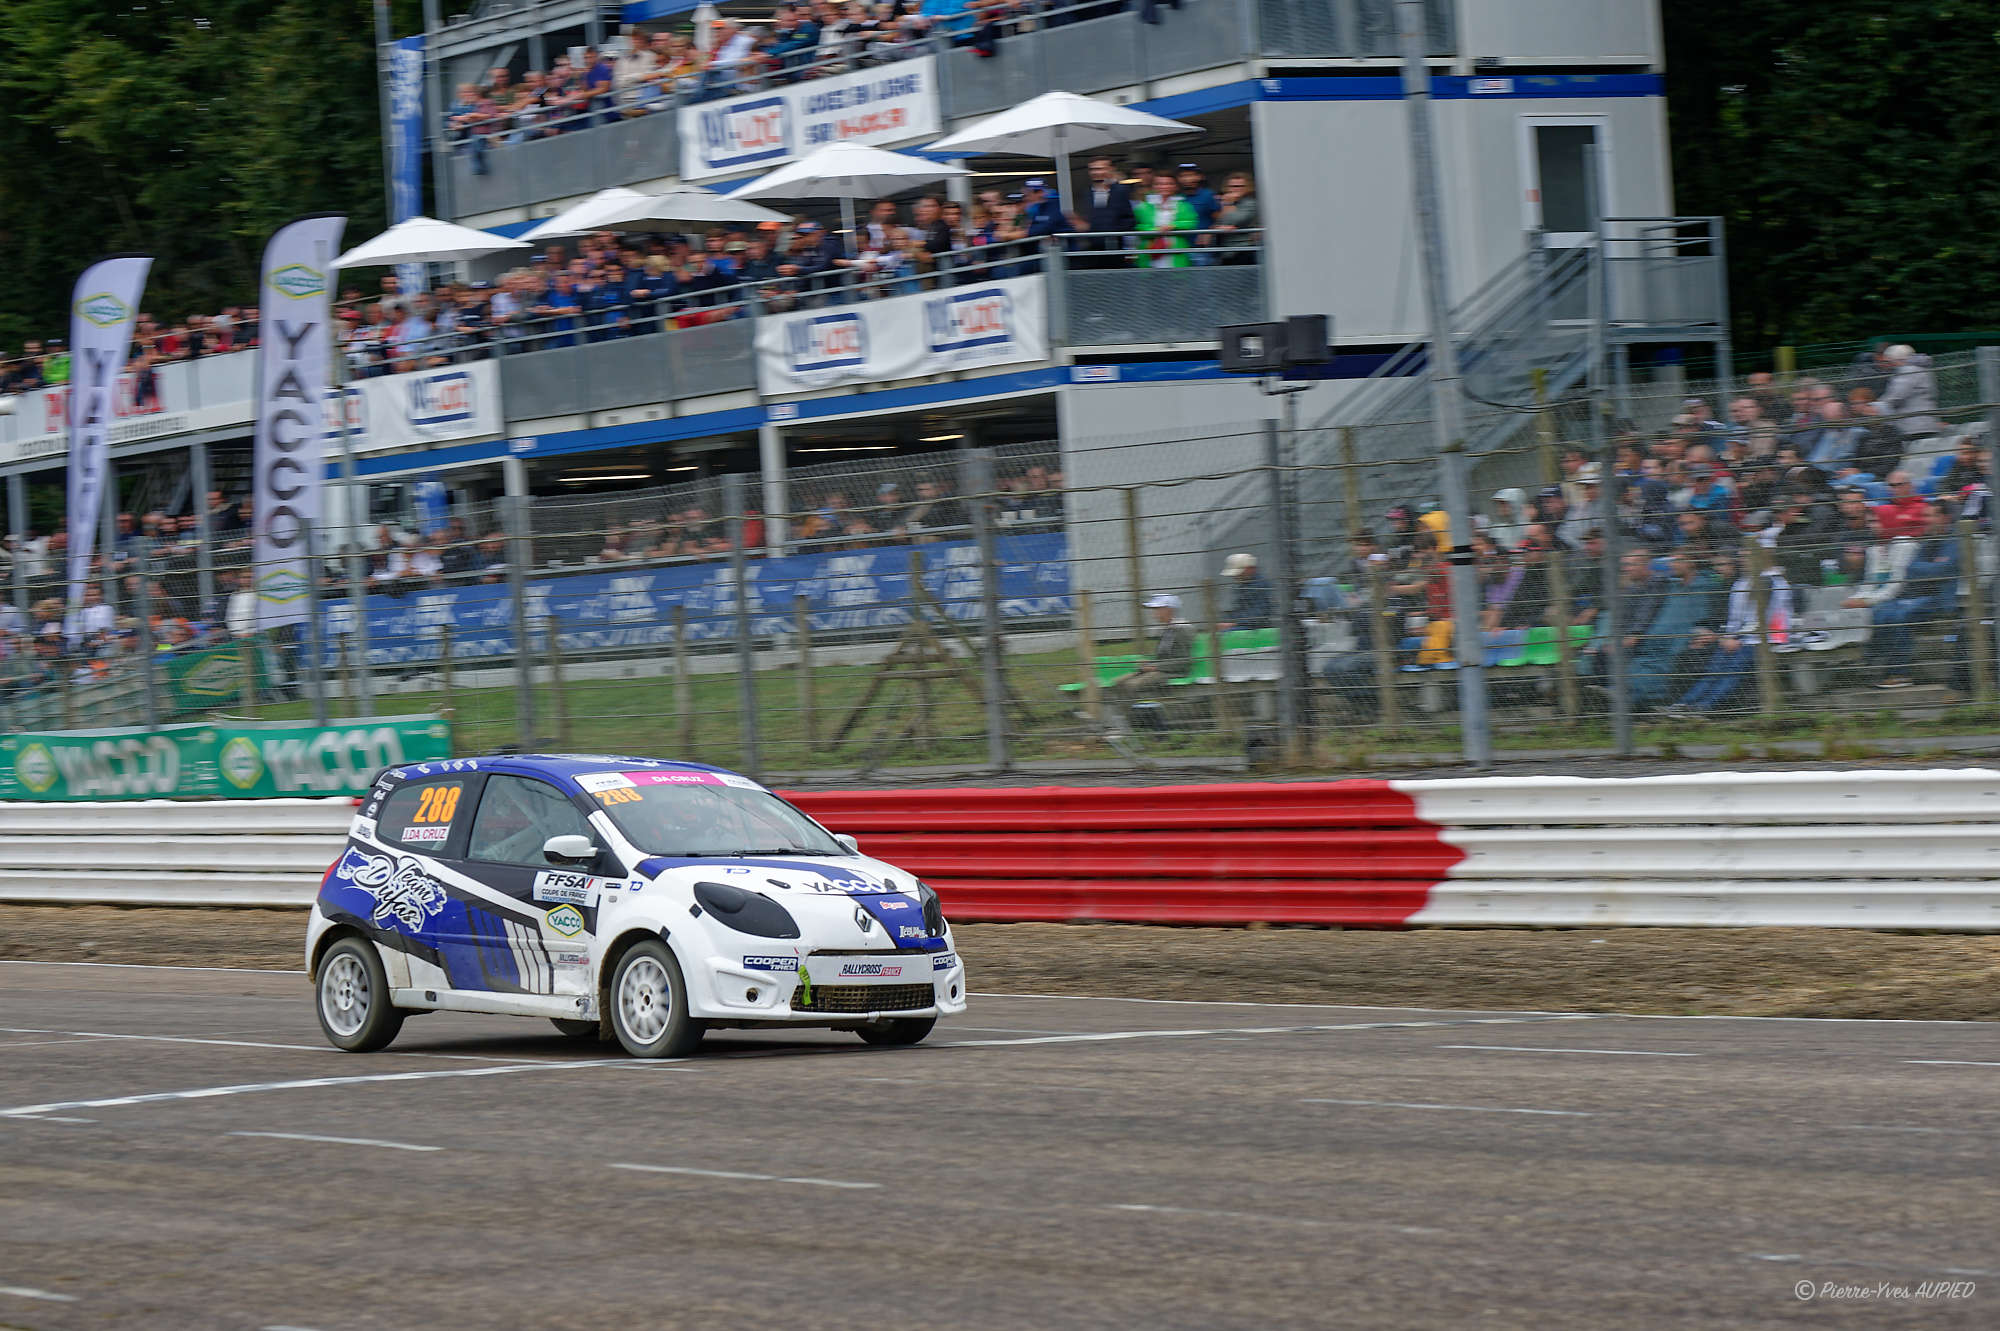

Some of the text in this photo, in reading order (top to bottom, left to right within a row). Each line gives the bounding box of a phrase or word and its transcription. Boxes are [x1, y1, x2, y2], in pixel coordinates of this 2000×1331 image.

[267, 319, 320, 548] YACCO
[594, 788, 643, 806] 288
[413, 786, 462, 823] 288
[422, 828, 447, 840] CRUZ
[544, 874, 586, 889] FFSA
[802, 879, 887, 893] YACCO
[541, 888, 559, 897] COUPE
[551, 915, 580, 928] YACCO
[744, 957, 798, 966] COOPER
[841, 963, 882, 975] RALLYCROSS
